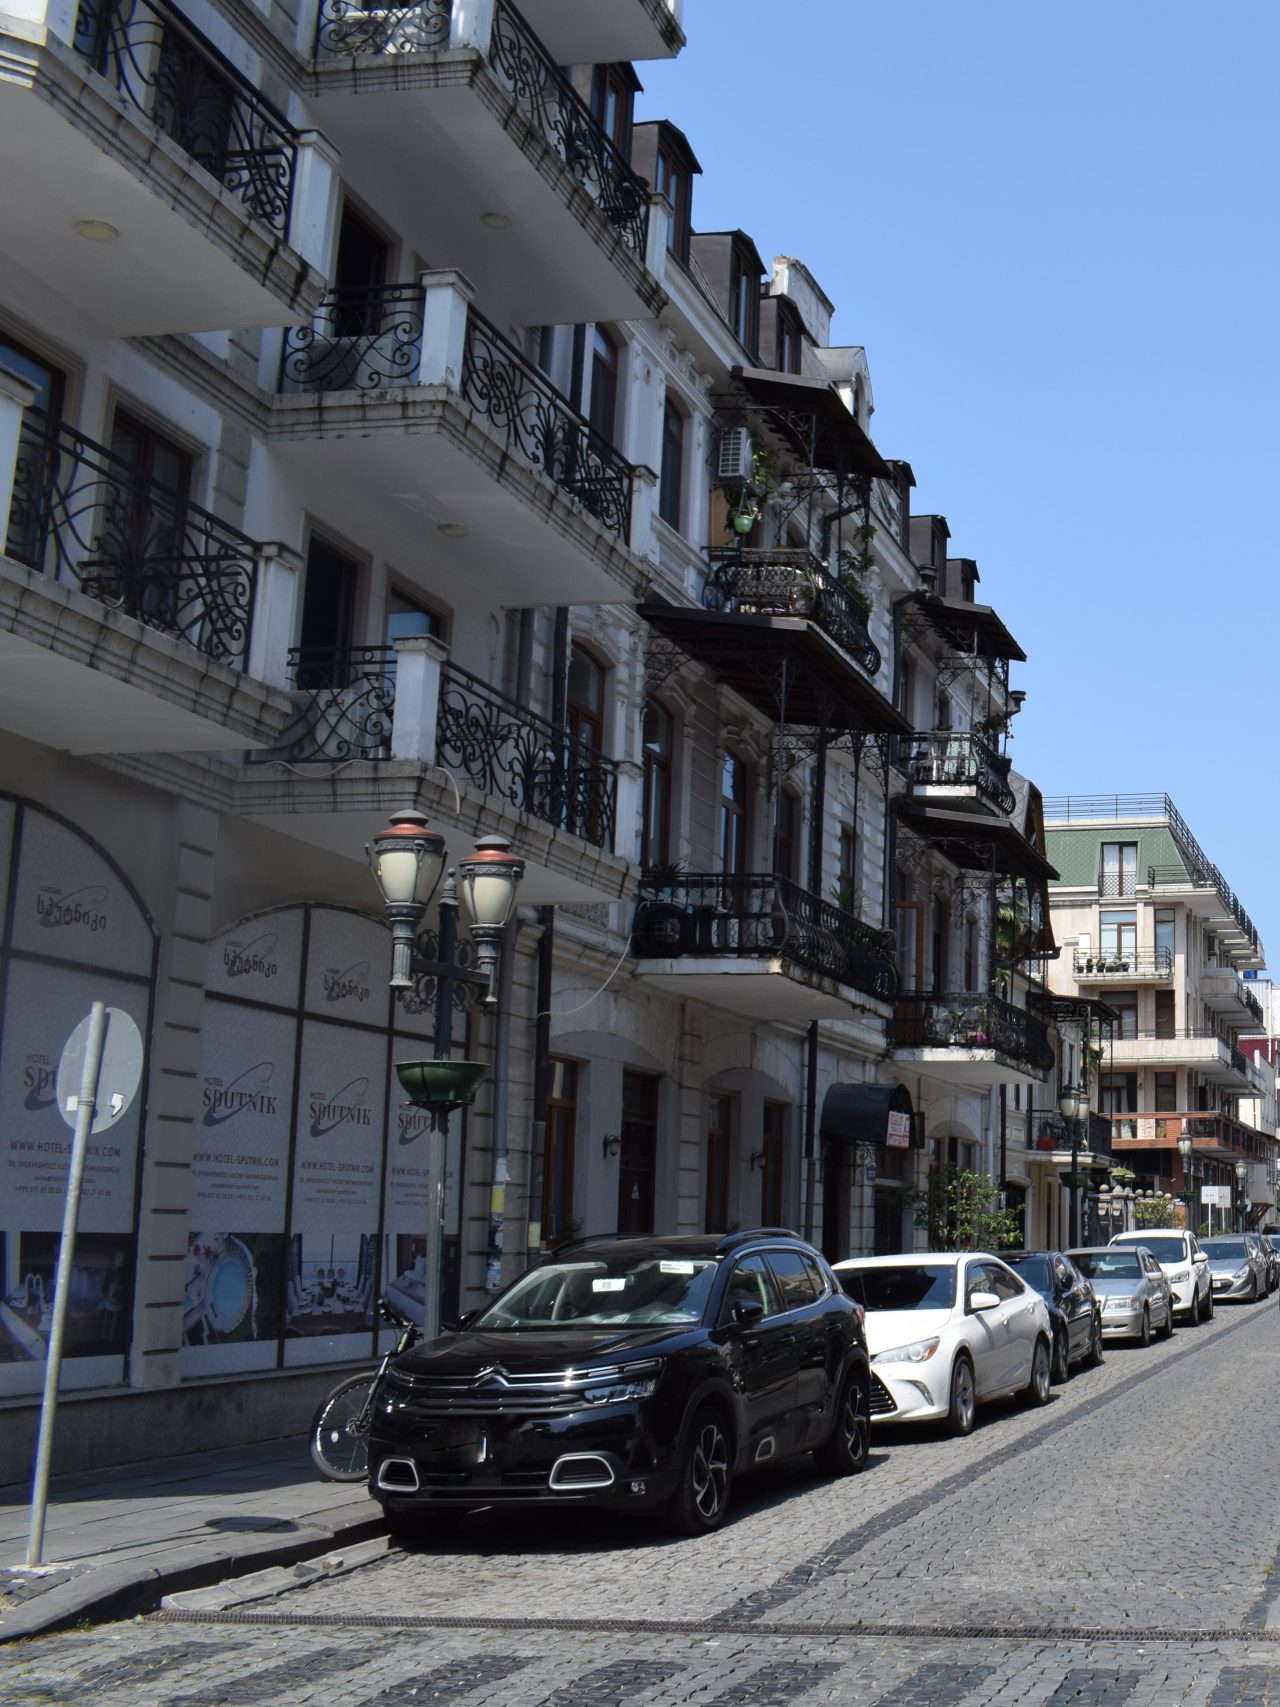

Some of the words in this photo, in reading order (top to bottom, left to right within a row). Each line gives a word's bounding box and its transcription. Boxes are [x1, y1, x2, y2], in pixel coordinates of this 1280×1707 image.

[26, 1054, 50, 1065] HOTEL
[204, 1076, 223, 1087] HOTEL
[202, 1087, 278, 1115] SPUTNIK
[309, 1101, 372, 1126] SPUTNIK
[192, 1152, 280, 1167] WWW.HOTEL-SPUTNIK.COM
